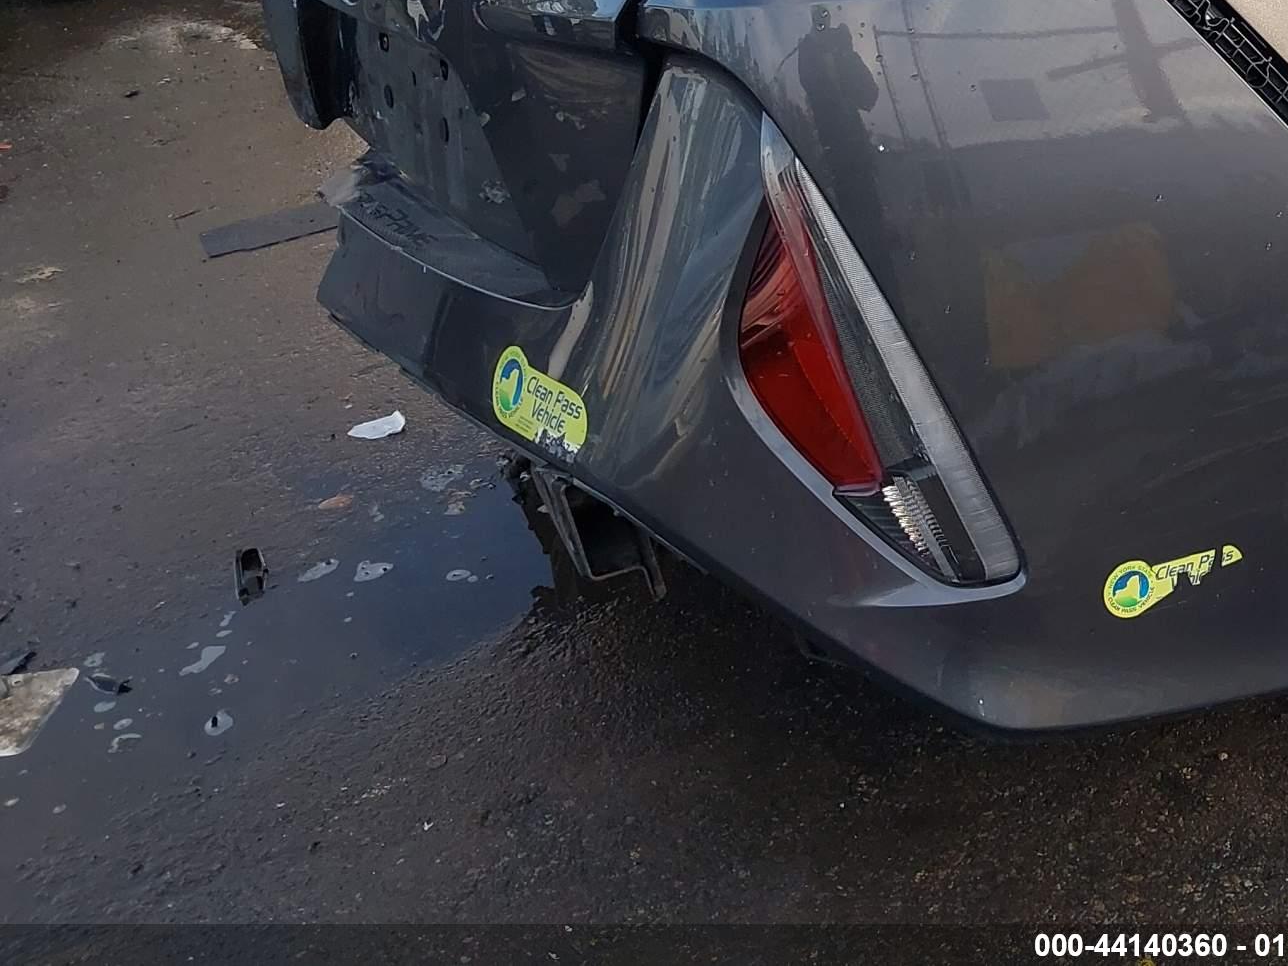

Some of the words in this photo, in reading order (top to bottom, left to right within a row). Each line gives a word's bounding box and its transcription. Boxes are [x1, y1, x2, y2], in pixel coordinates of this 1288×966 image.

[526, 376, 554, 405] Clean
[553, 390, 583, 420] Pass
[531, 399, 566, 434] Vehicle
[1155, 562, 1194, 580] Clean
